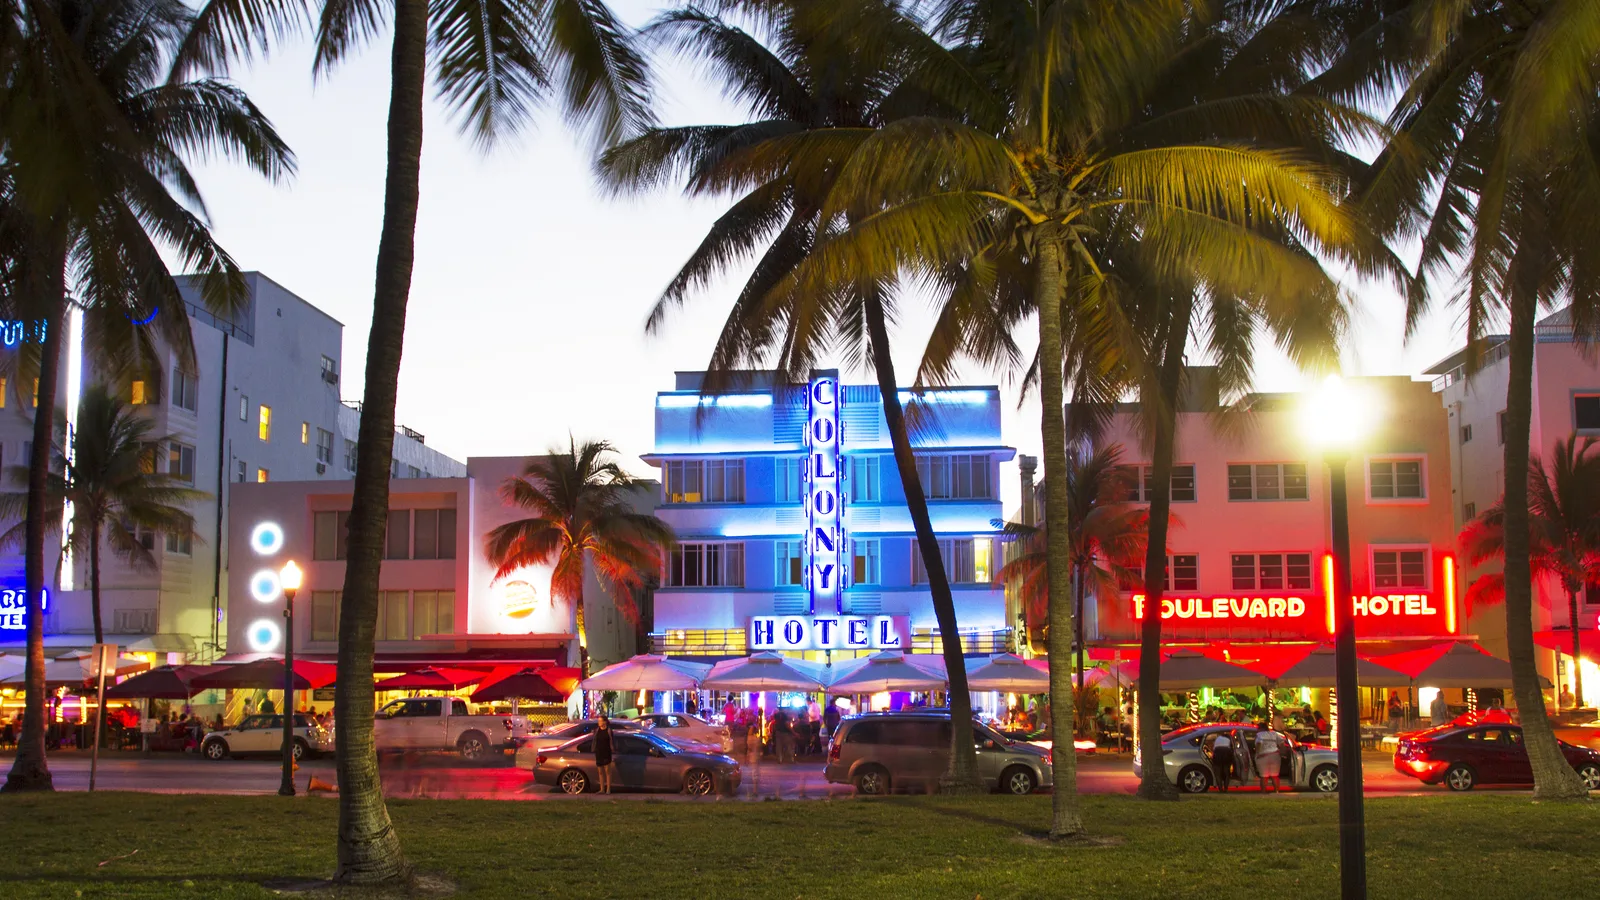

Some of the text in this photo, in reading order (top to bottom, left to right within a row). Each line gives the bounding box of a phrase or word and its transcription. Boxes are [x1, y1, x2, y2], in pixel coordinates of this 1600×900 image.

[813, 379, 835, 589] COLONY
[1352, 594, 1438, 617] HOTEL
[754, 619, 899, 645] HOTEL
